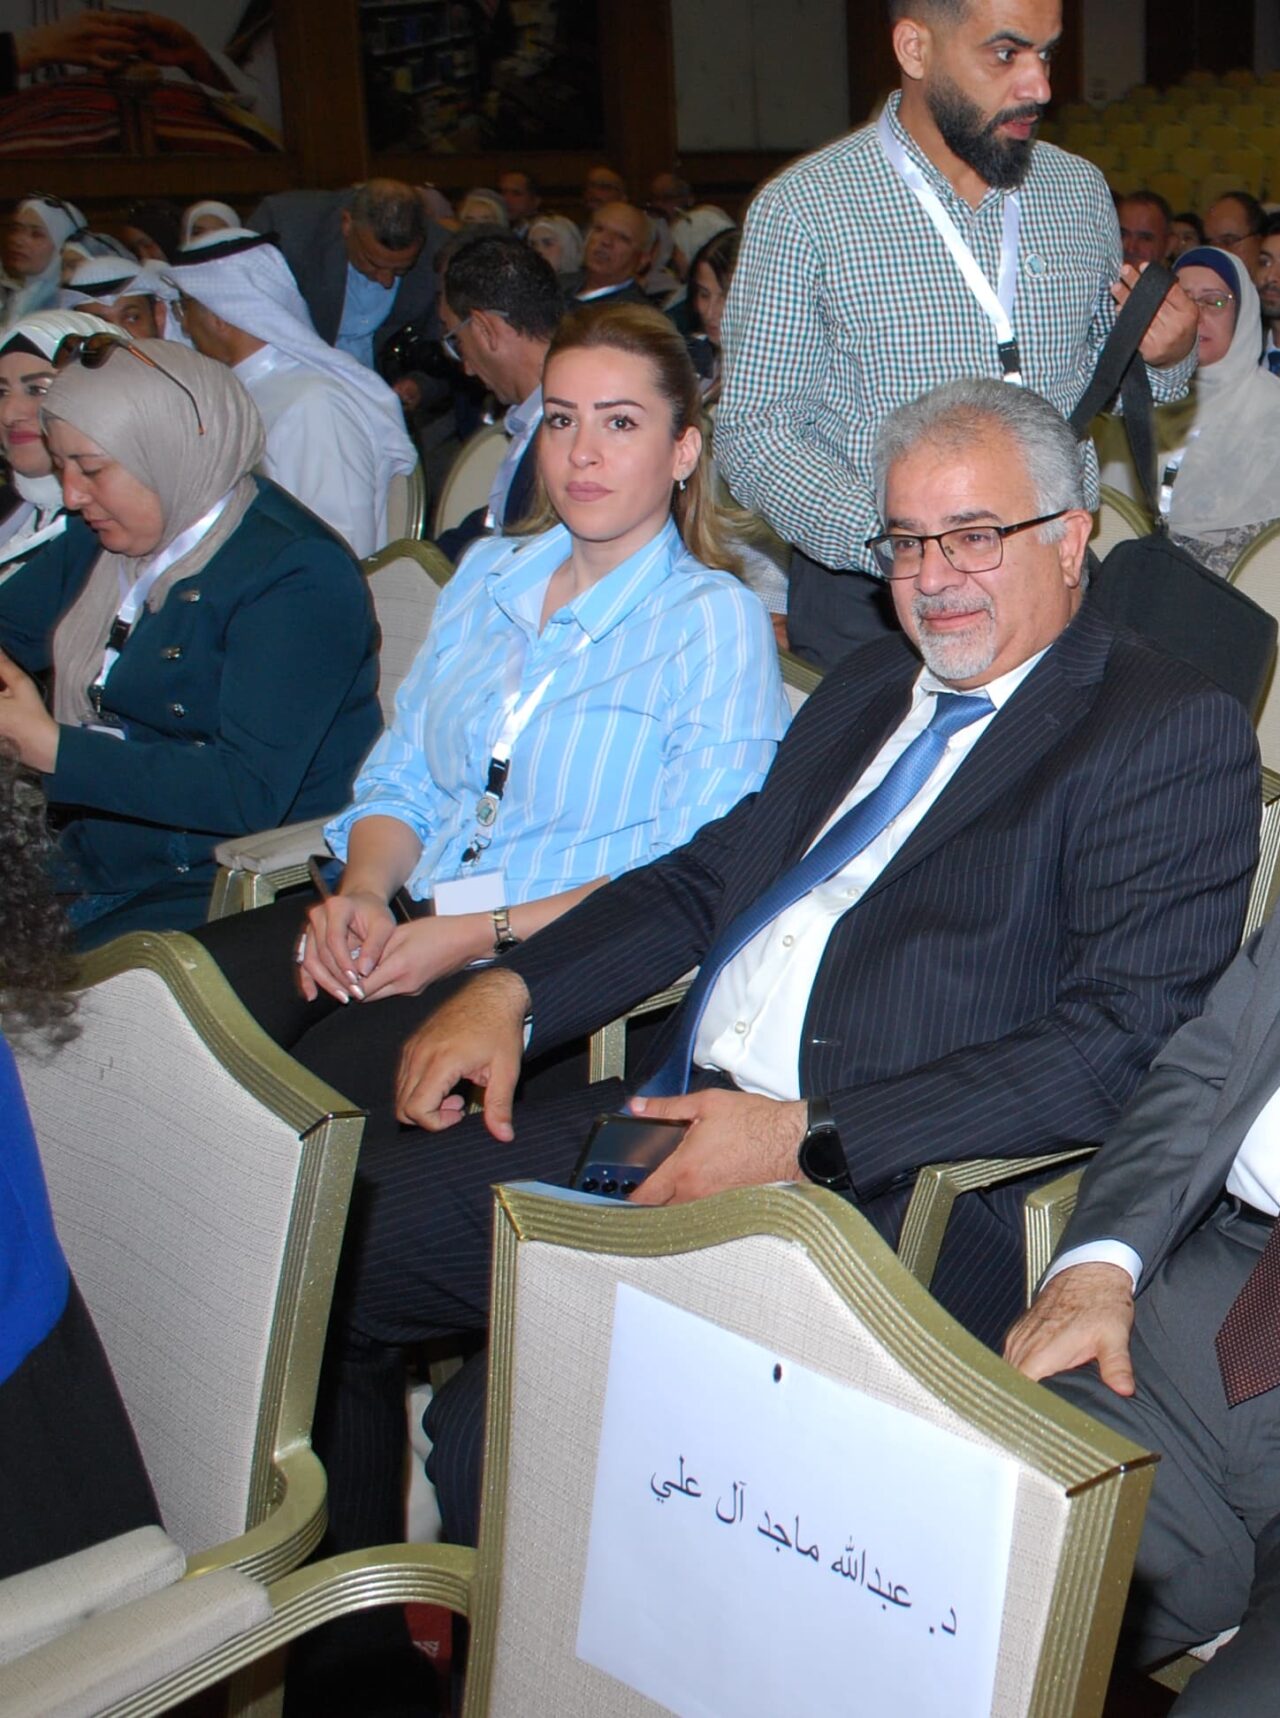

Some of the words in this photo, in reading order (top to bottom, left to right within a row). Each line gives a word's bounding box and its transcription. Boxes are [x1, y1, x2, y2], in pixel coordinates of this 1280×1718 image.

[650, 1455, 702, 1503] علي
[715, 1481, 747, 1524] آل
[757, 1510, 820, 1562] ماجد
[830, 1535, 912, 1610] عبدالله
[928, 1607, 957, 1636] د.
